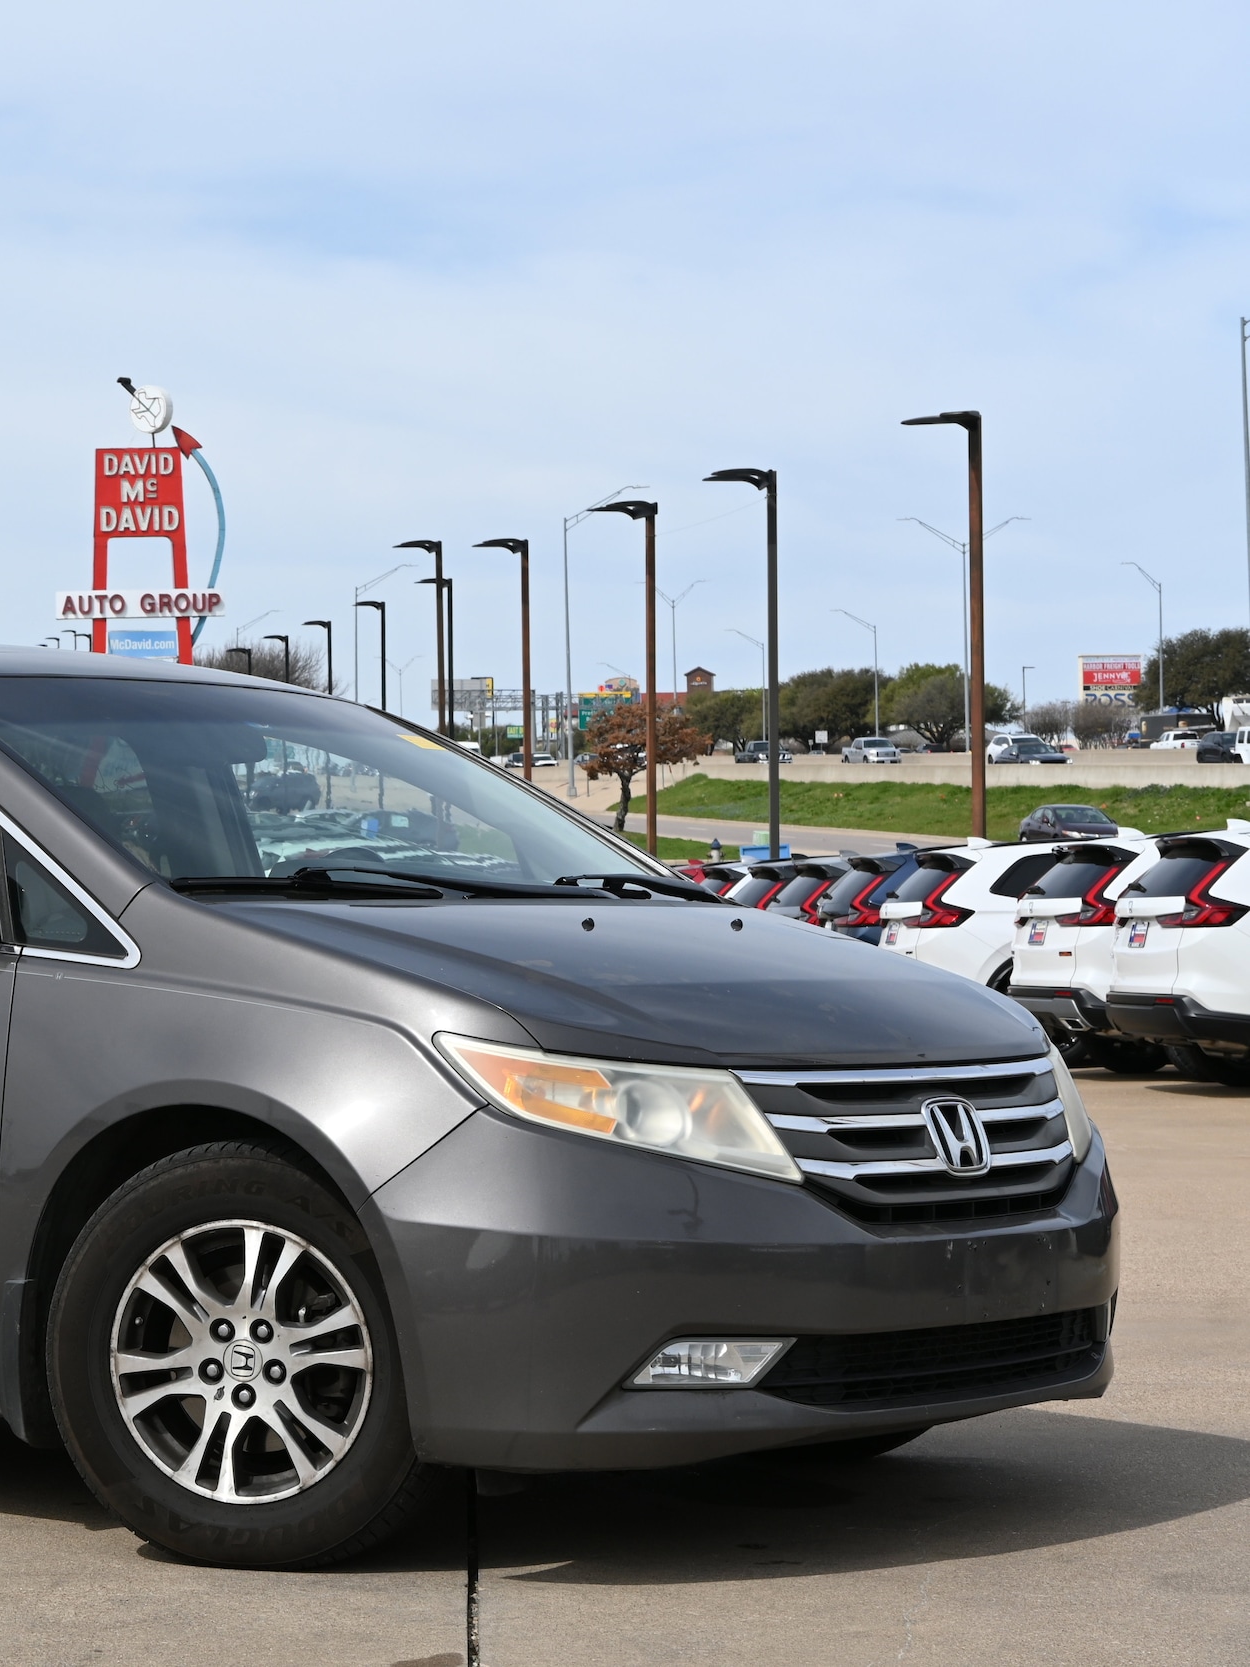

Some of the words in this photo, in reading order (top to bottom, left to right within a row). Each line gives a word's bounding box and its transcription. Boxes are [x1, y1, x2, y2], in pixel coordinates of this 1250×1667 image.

[103, 452, 175, 477] DAVID
[99, 505, 180, 532] DAVID
[62, 593, 126, 616] AUTO
[140, 592, 222, 615] GROUP
[110, 639, 175, 650] McDavid.com
[1093, 672, 1122, 682] JENNY
